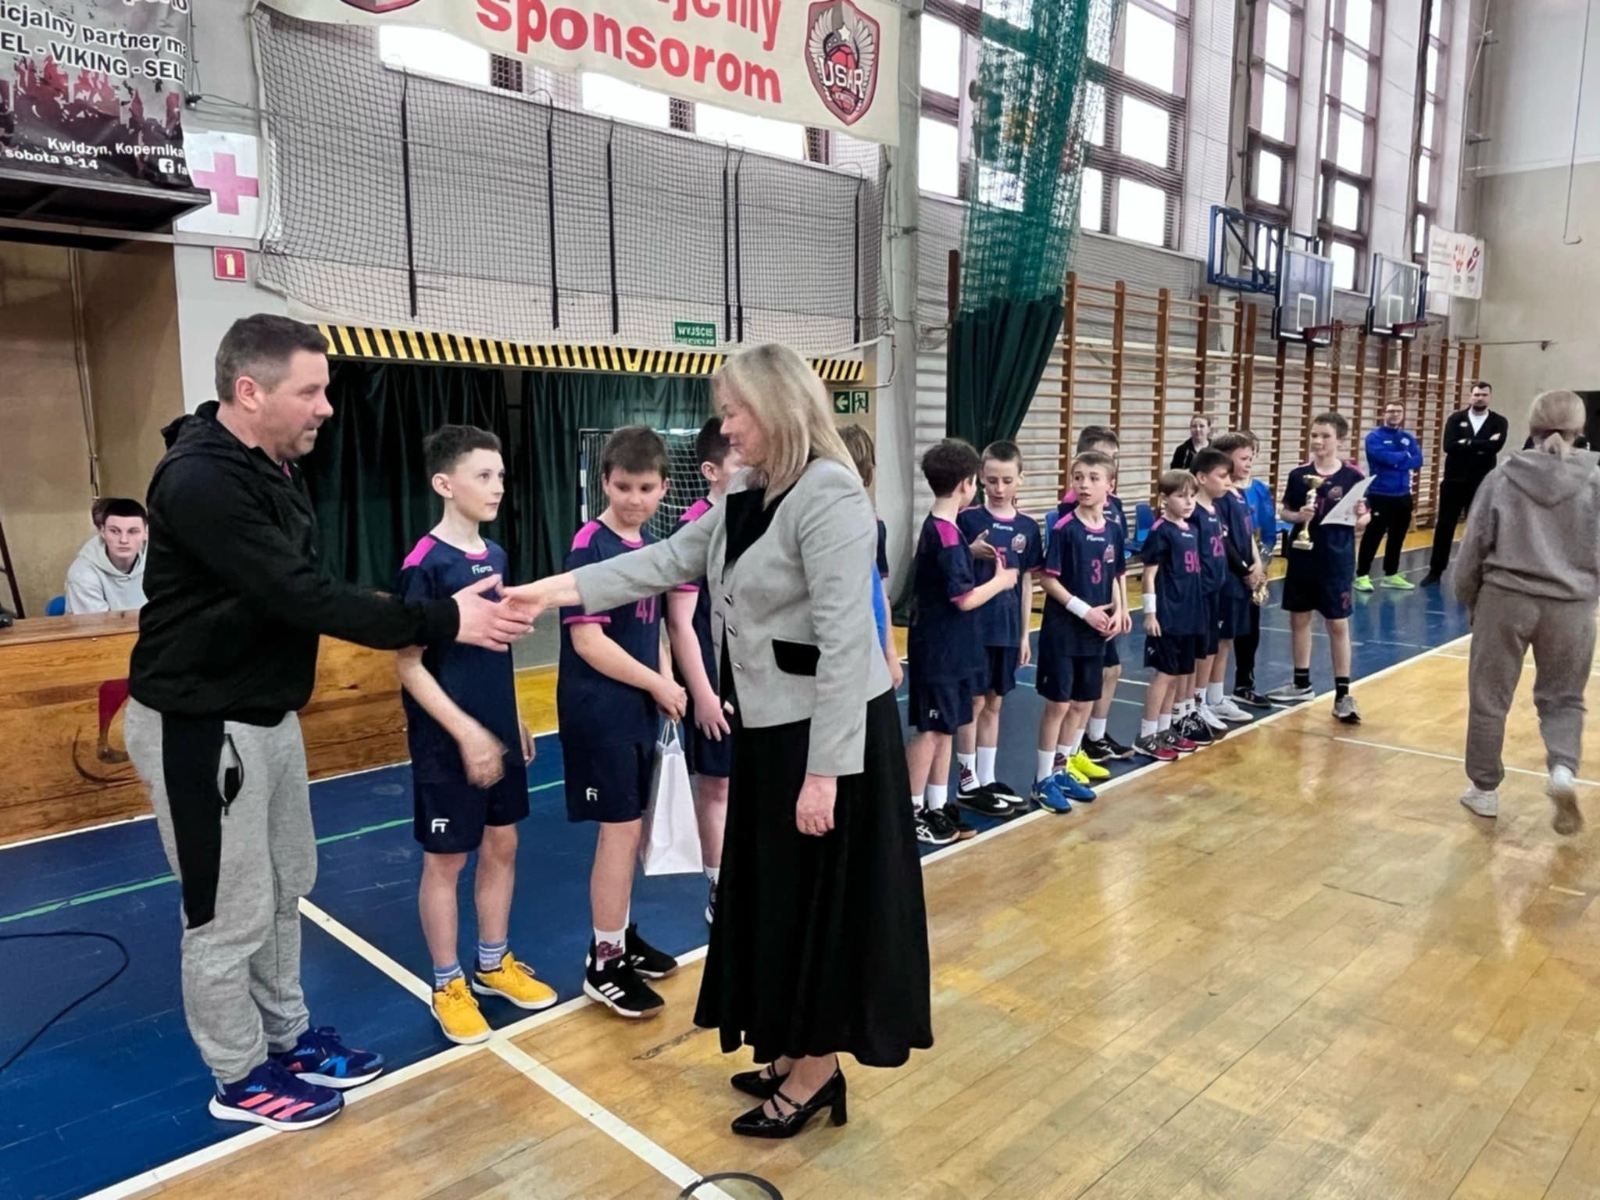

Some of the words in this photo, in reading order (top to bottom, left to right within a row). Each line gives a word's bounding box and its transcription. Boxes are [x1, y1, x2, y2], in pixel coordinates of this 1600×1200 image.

[82, 26, 160, 50] partner
[51, 41, 128, 76] VIKING
[476, 0, 782, 103] sponsorom
[5, 149, 60, 165] sobota
[63, 155, 99, 170] 9-14
[115, 142, 185, 158] Kopernika
[1091, 559, 1101, 584] 3
